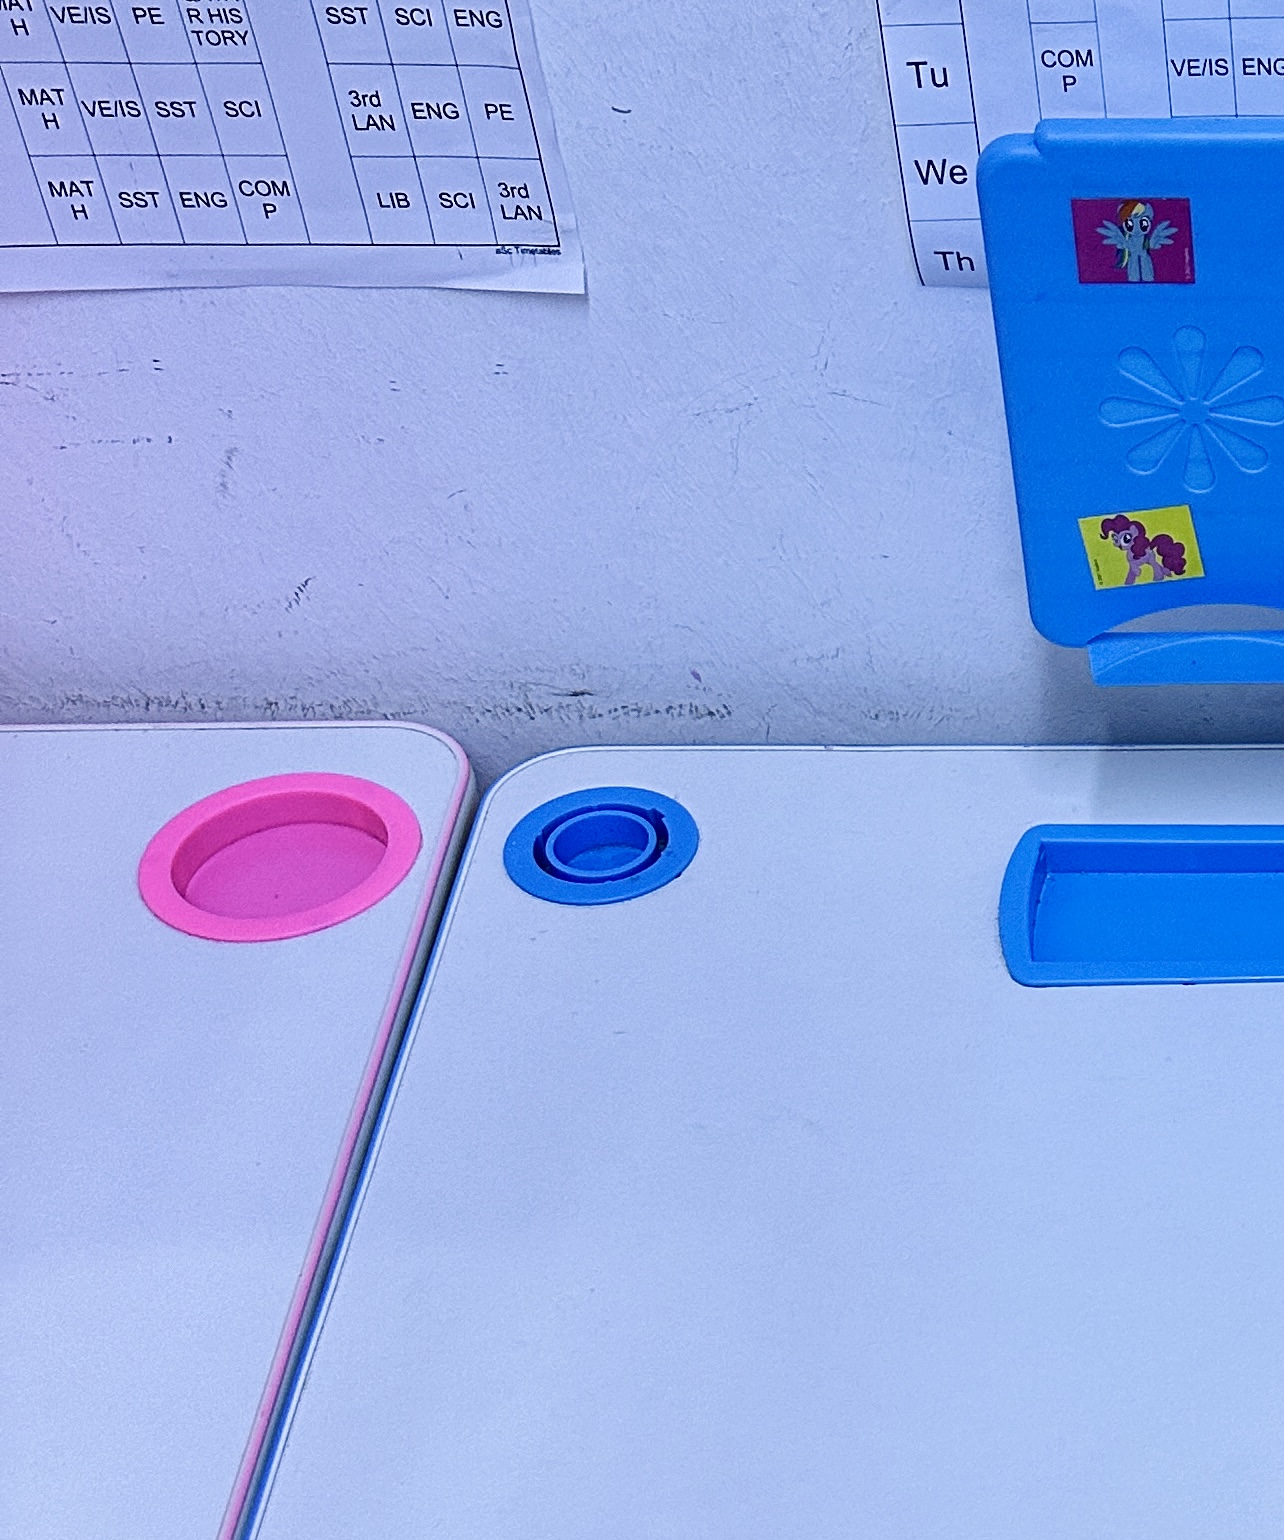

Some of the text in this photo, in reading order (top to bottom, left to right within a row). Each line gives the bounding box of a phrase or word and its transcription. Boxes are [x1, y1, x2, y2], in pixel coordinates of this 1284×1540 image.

[50, 7, 111, 24] VE/IS
[132, 7, 165, 24] PE
[187, 8, 243, 24] R HIS
[325, 7, 368, 24] SST
[394, 8, 433, 26] SCI
[453, 9, 503, 28] ENG
[10, 18, 29, 36] H
[191, 30, 248, 46] TORY
[1041, 50, 1094, 68] COM
[1171, 58, 1229, 76] VE/IS
[906, 60, 949, 88] Tu
[1062, 75, 1077, 92] P
[18, 88, 64, 105] MAT
[348, 90, 381, 107] 3rd
[81, 100, 141, 117] VE/IS
[154, 101, 197, 117] SST
[223, 101, 262, 117] SCI
[411, 102, 460, 119] ENG
[484, 103, 515, 120] PE
[42, 112, 60, 129] H
[351, 114, 396, 131] LAN
[914, 158, 968, 185] We
[48, 181, 94, 197] MAT
[238, 180, 291, 196] COM
[498, 182, 530, 199] 3rd
[118, 192, 159, 208] SST
[179, 192, 228, 208] ENG
[377, 192, 411, 208] LIB
[439, 192, 476, 209] SCI
[70, 204, 89, 220] H
[262, 203, 277, 219] P
[501, 204, 543, 221] LAN
[933, 250, 975, 271] Th
